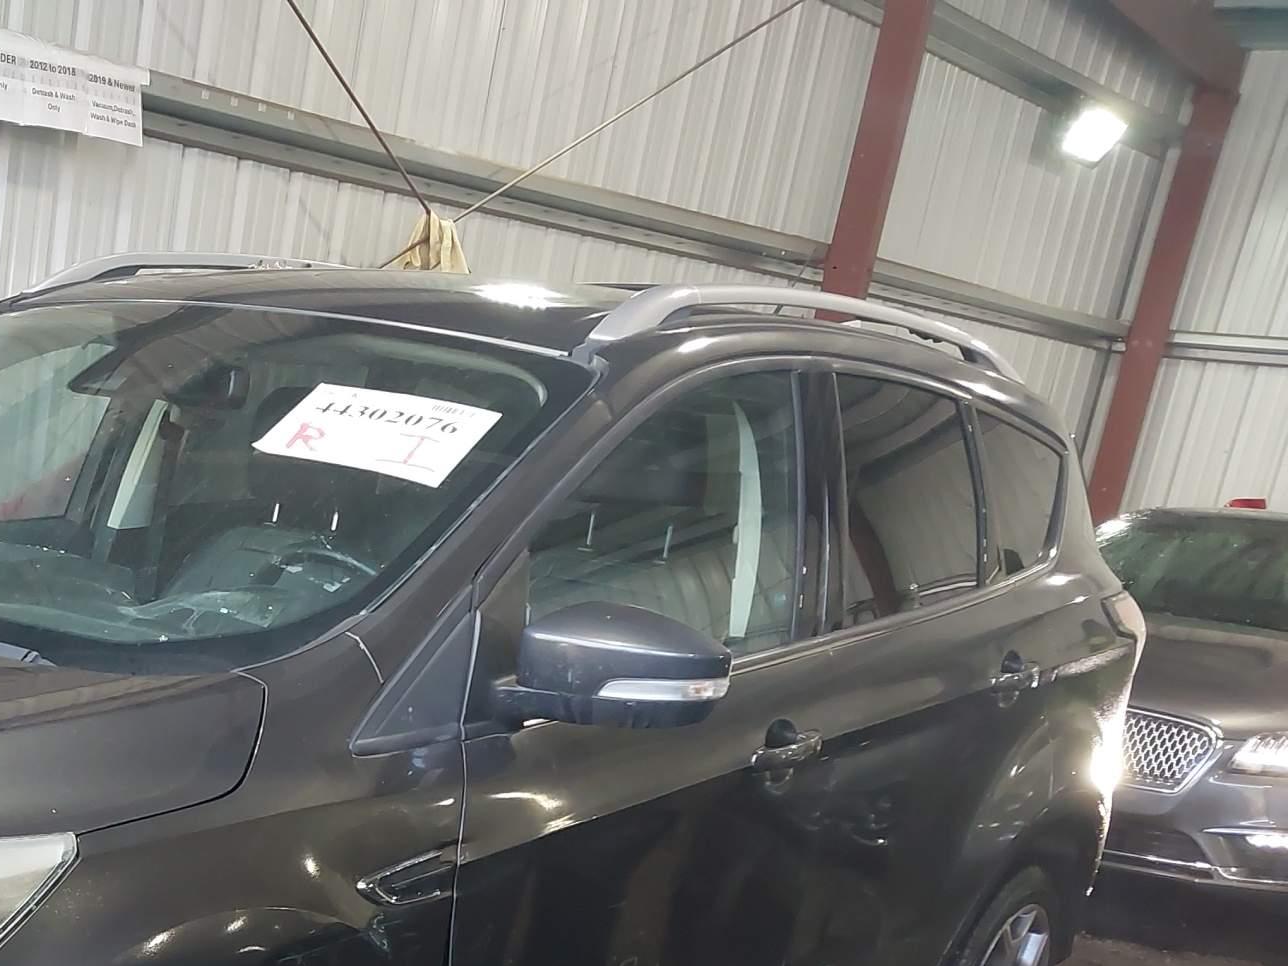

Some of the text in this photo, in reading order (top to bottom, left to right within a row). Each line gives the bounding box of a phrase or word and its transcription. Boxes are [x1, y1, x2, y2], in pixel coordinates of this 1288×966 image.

[29, 60, 48, 71] 2012
[49, 63, 57, 73] to
[87, 73, 107, 85] 2019
[107, 77, 113, 87] &
[315, 401, 459, 434] 44302076
[285, 422, 326, 452] R
